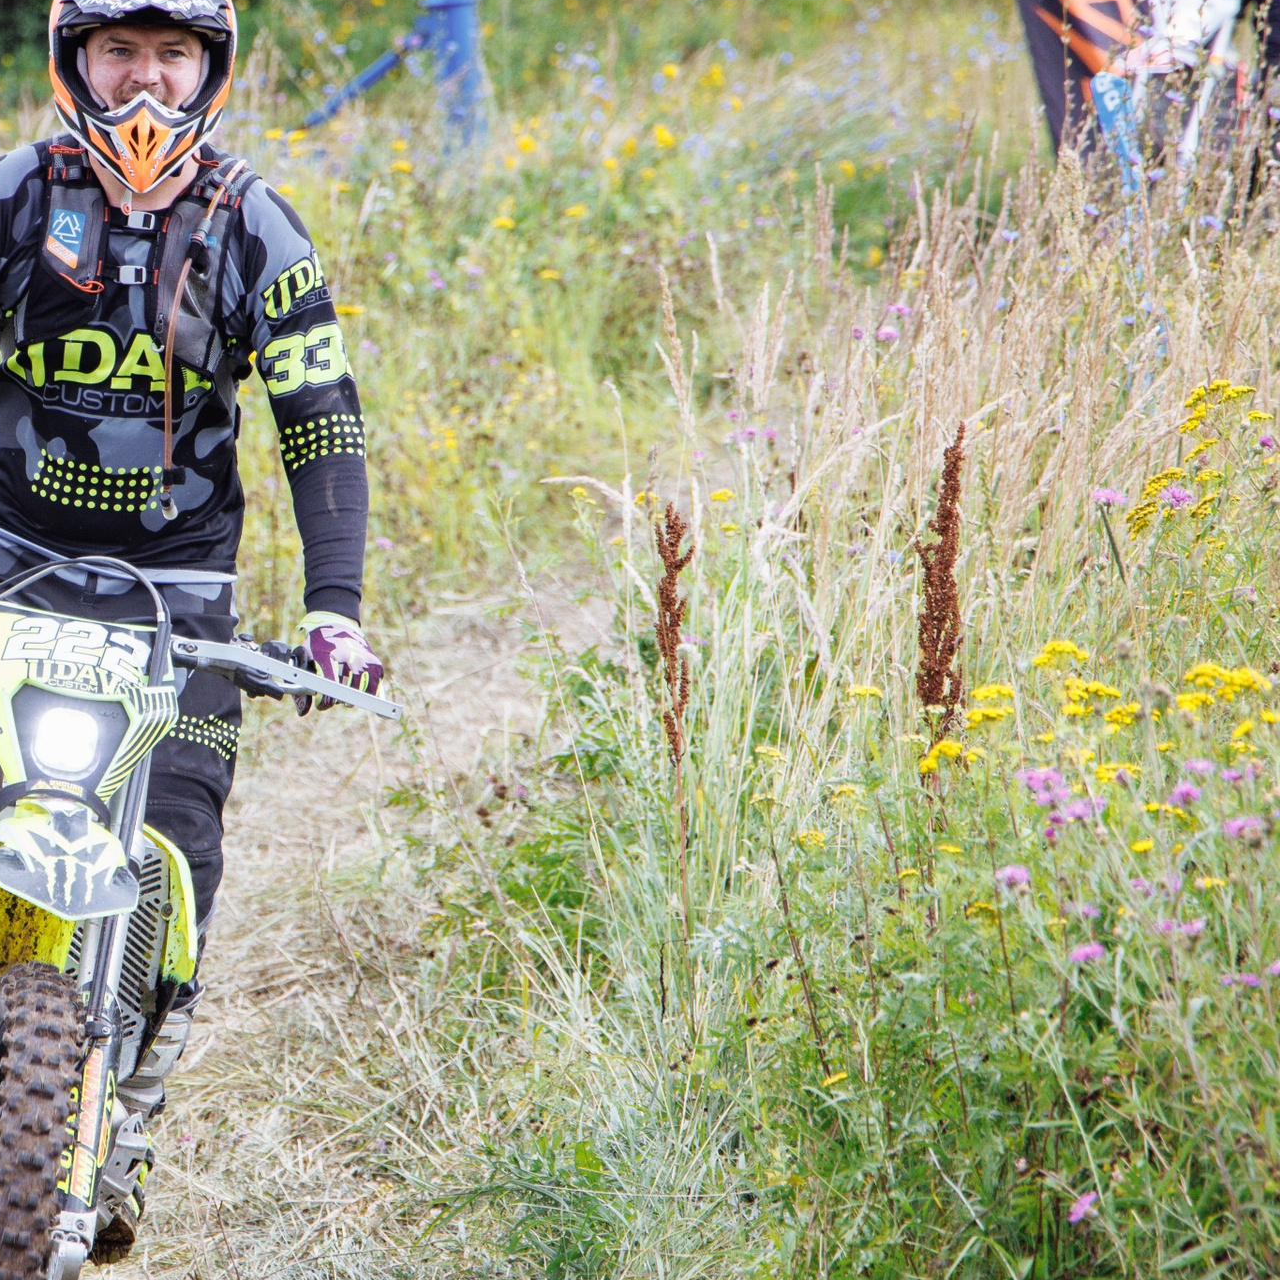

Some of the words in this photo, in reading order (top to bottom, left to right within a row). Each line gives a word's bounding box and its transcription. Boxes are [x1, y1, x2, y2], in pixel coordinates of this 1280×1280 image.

[264, 323, 355, 397] 33
[43, 382, 167, 413] CUSTOM
[1, 617, 152, 688] 222
[48, 679, 98, 693] CUSTOM
